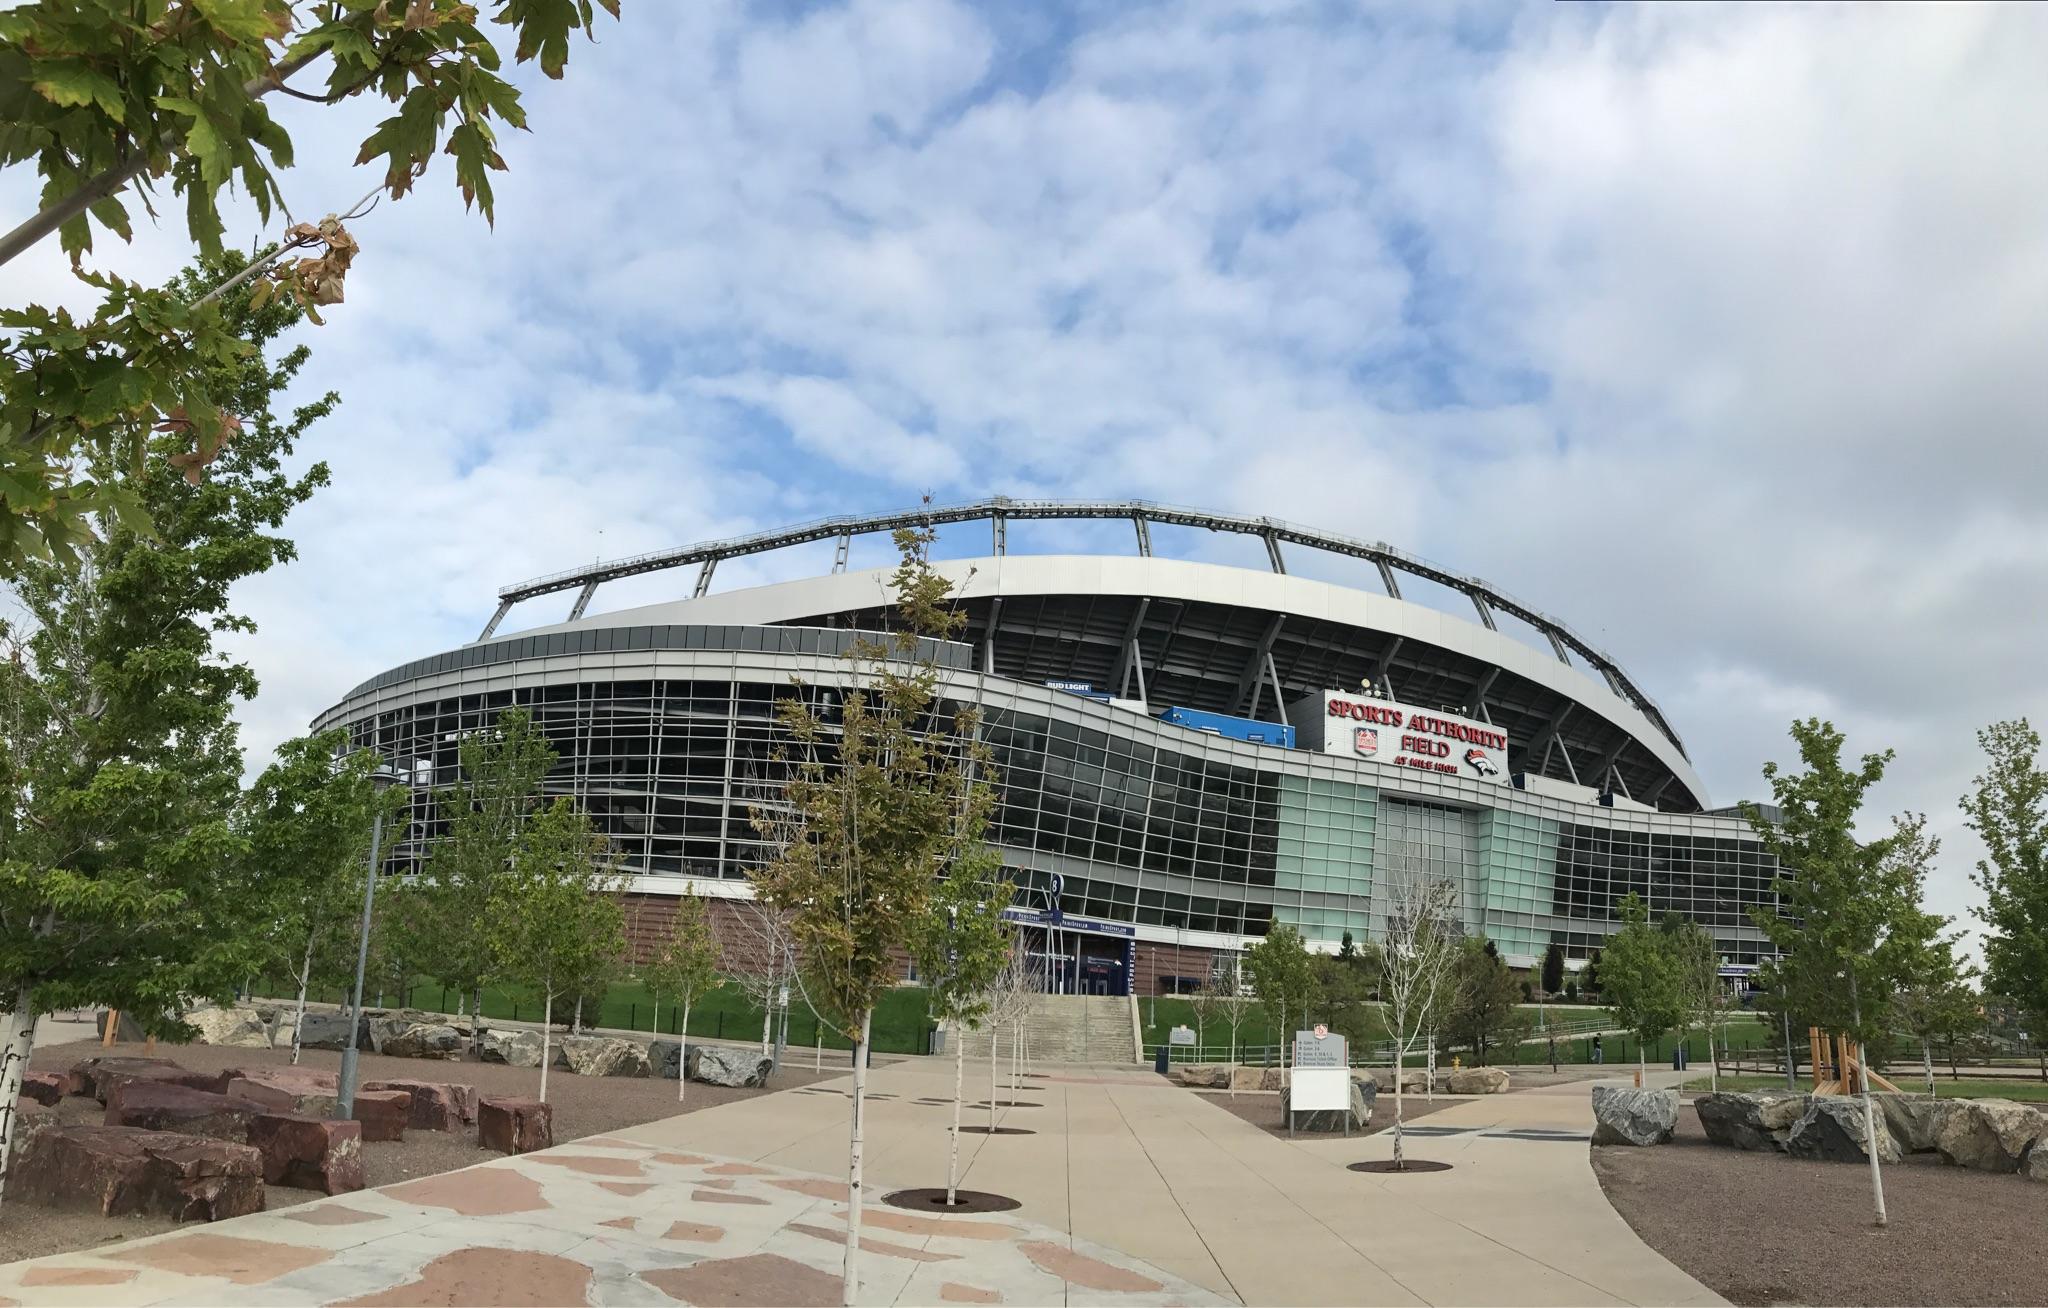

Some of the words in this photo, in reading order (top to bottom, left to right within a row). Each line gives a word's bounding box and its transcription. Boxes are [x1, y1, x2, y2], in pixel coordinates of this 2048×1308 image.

[1065, 683, 1089, 691] LIGHT
[1328, 699, 1403, 727] SPORTS
[1408, 714, 1507, 750] AUTHORITY
[1401, 735, 1451, 758] FIELD
[1394, 755, 1408, 765] AT
[1409, 758, 1434, 770] MILE
[1434, 762, 1458, 774] HIGH
[1052, 879, 1058, 893] 8
